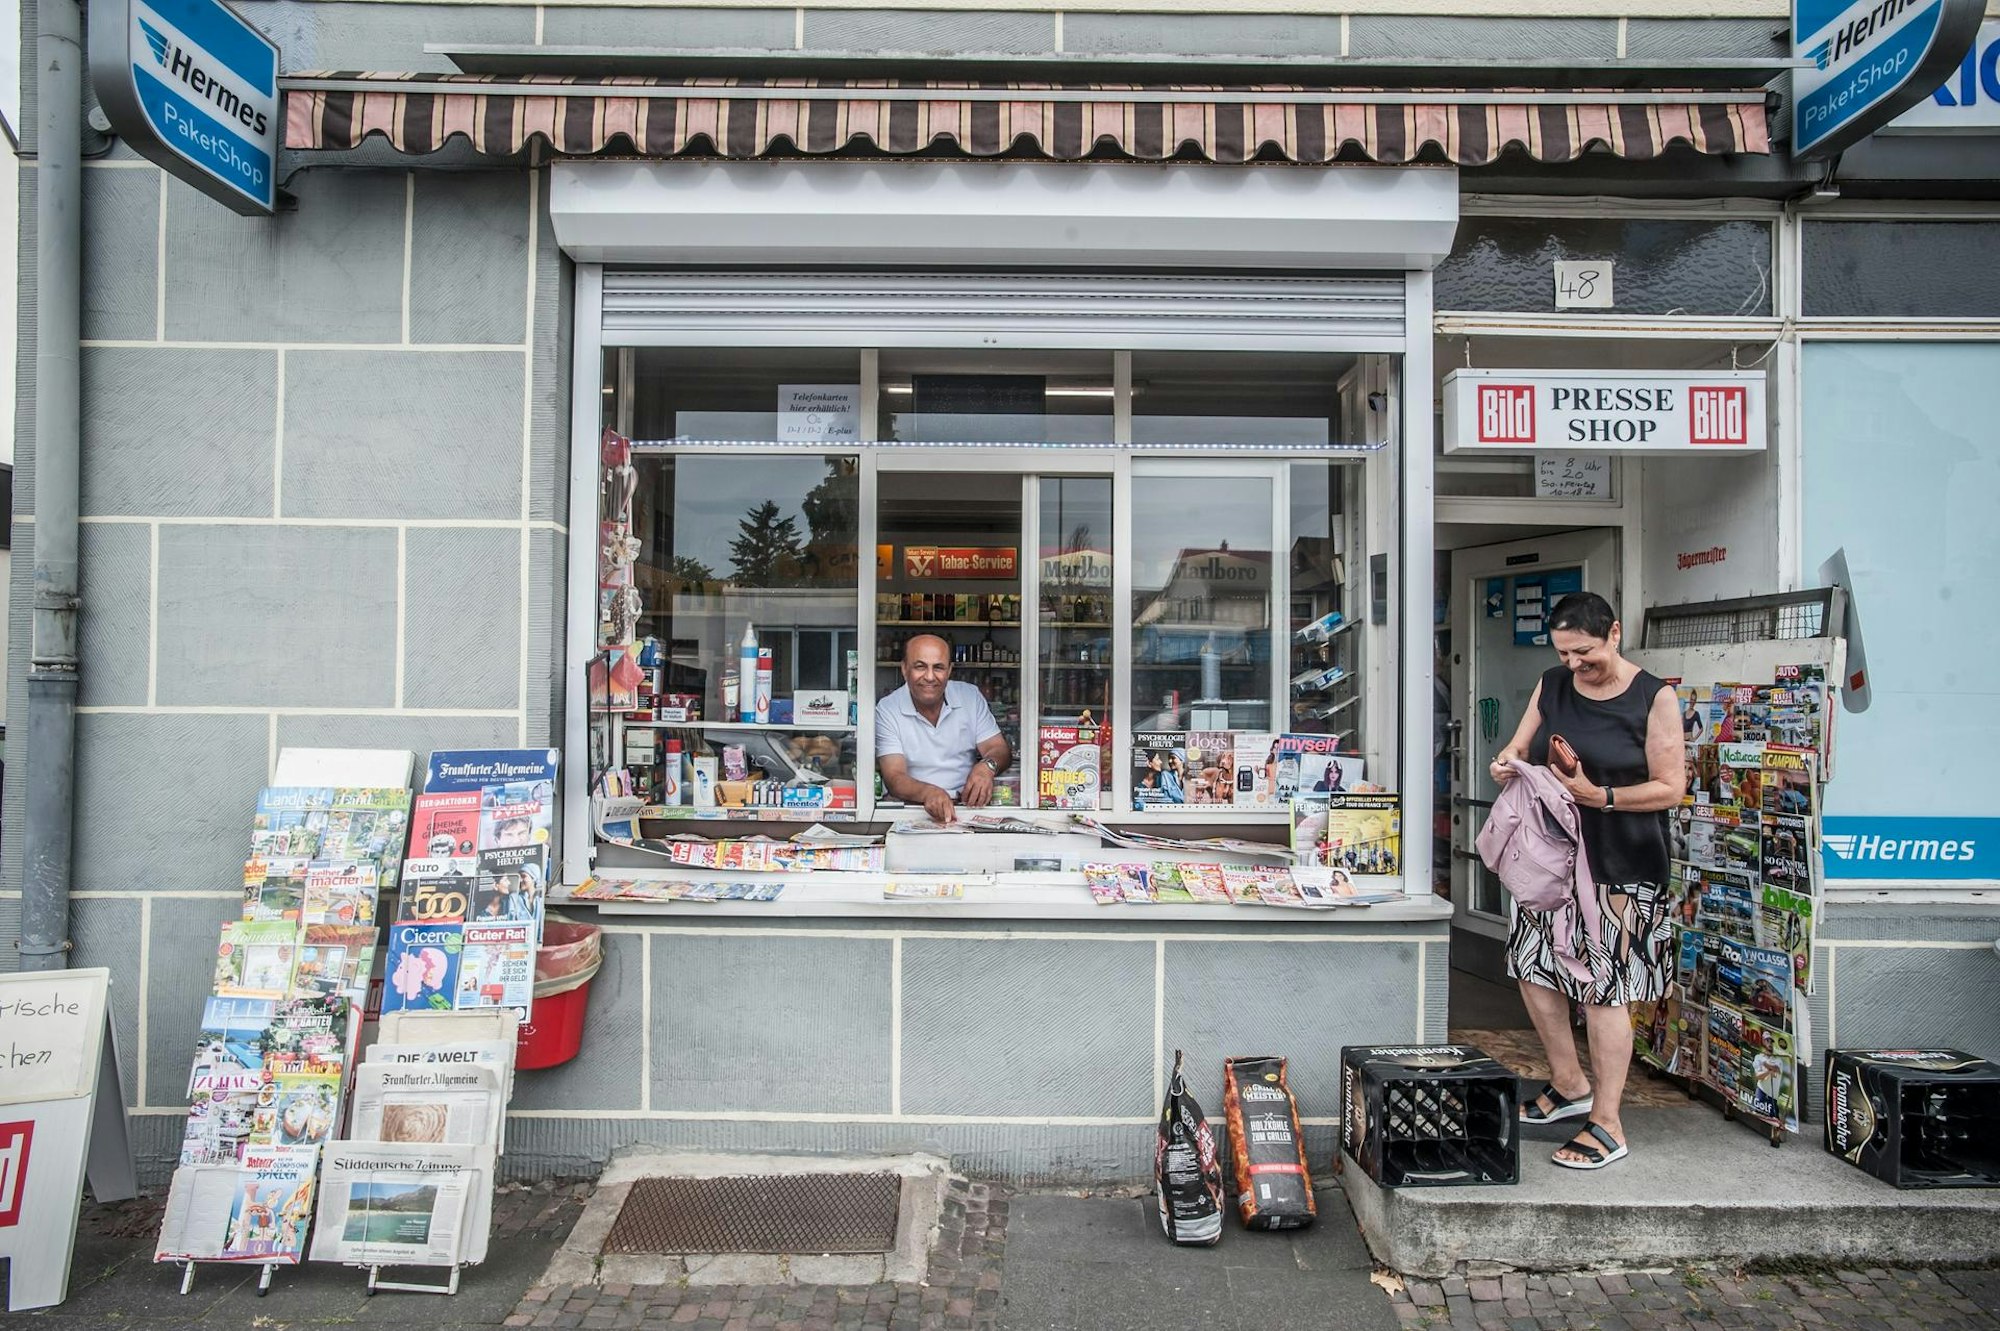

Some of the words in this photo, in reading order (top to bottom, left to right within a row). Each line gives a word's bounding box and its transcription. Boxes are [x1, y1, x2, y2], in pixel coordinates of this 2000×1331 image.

[171, 47, 267, 136] Hermes
[1804, 48, 1908, 131] PaketShop
[164, 102, 264, 187] PaketShop
[1559, 270, 1600, 299] 48
[793, 392, 848, 402] Telefonkarten
[1550, 387, 1674, 412] PRESSE
[790, 404, 806, 412] hier
[808, 404, 851, 412] erhältlich!
[1482, 388, 1533, 439] Bild
[1693, 391, 1743, 440] Bild
[828, 427, 852, 435] E-plus
[1567, 418, 1657, 442] SHOP
[1562, 469, 1584, 479] 20
[940, 554, 1013, 570] Tabac-Service
[1776, 665, 1799, 676] AUTO
[1736, 687, 1752, 696] AUTO
[1736, 695, 1752, 703] TEST
[1044, 729, 1075, 739] kicker
[1189, 733, 1227, 753] dogs
[1280, 737, 1339, 753] myself
[1766, 755, 1805, 769] CAMPING
[439, 762, 492, 778] Frankfurter
[491, 762, 544, 777] Allgemeine
[1040, 771, 1086, 784] BUNDES
[1040, 783, 1066, 796] LIGA
[484, 848, 537, 860] PSYCHOLOGIE
[1857, 835, 1975, 861] Hermes
[497, 857, 525, 866] HEUTE
[311, 875, 363, 886] machen
[411, 886, 467, 919] 500
[401, 928, 451, 944] Cicero
[469, 930, 503, 941] Guter
[506, 928, 525, 940] Rat
[1758, 953, 1788, 967] CLASSIC
[397, 1053, 420, 1062] DIE
[382, 1073, 431, 1087] Frankfurter
[431, 1072, 478, 1087] Allgemeine
[1754, 1098, 1772, 1114] Golf
[1836, 1070, 1851, 1150] Krombacher
[1250, 1120, 1289, 1131] HOLZKOHLE
[1252, 1132, 1267, 1142] ZUM
[1267, 1132, 1292, 1141] GRILLEN
[334, 1158, 414, 1171] Süddeutsche
[415, 1159, 463, 1176] Zeitung
